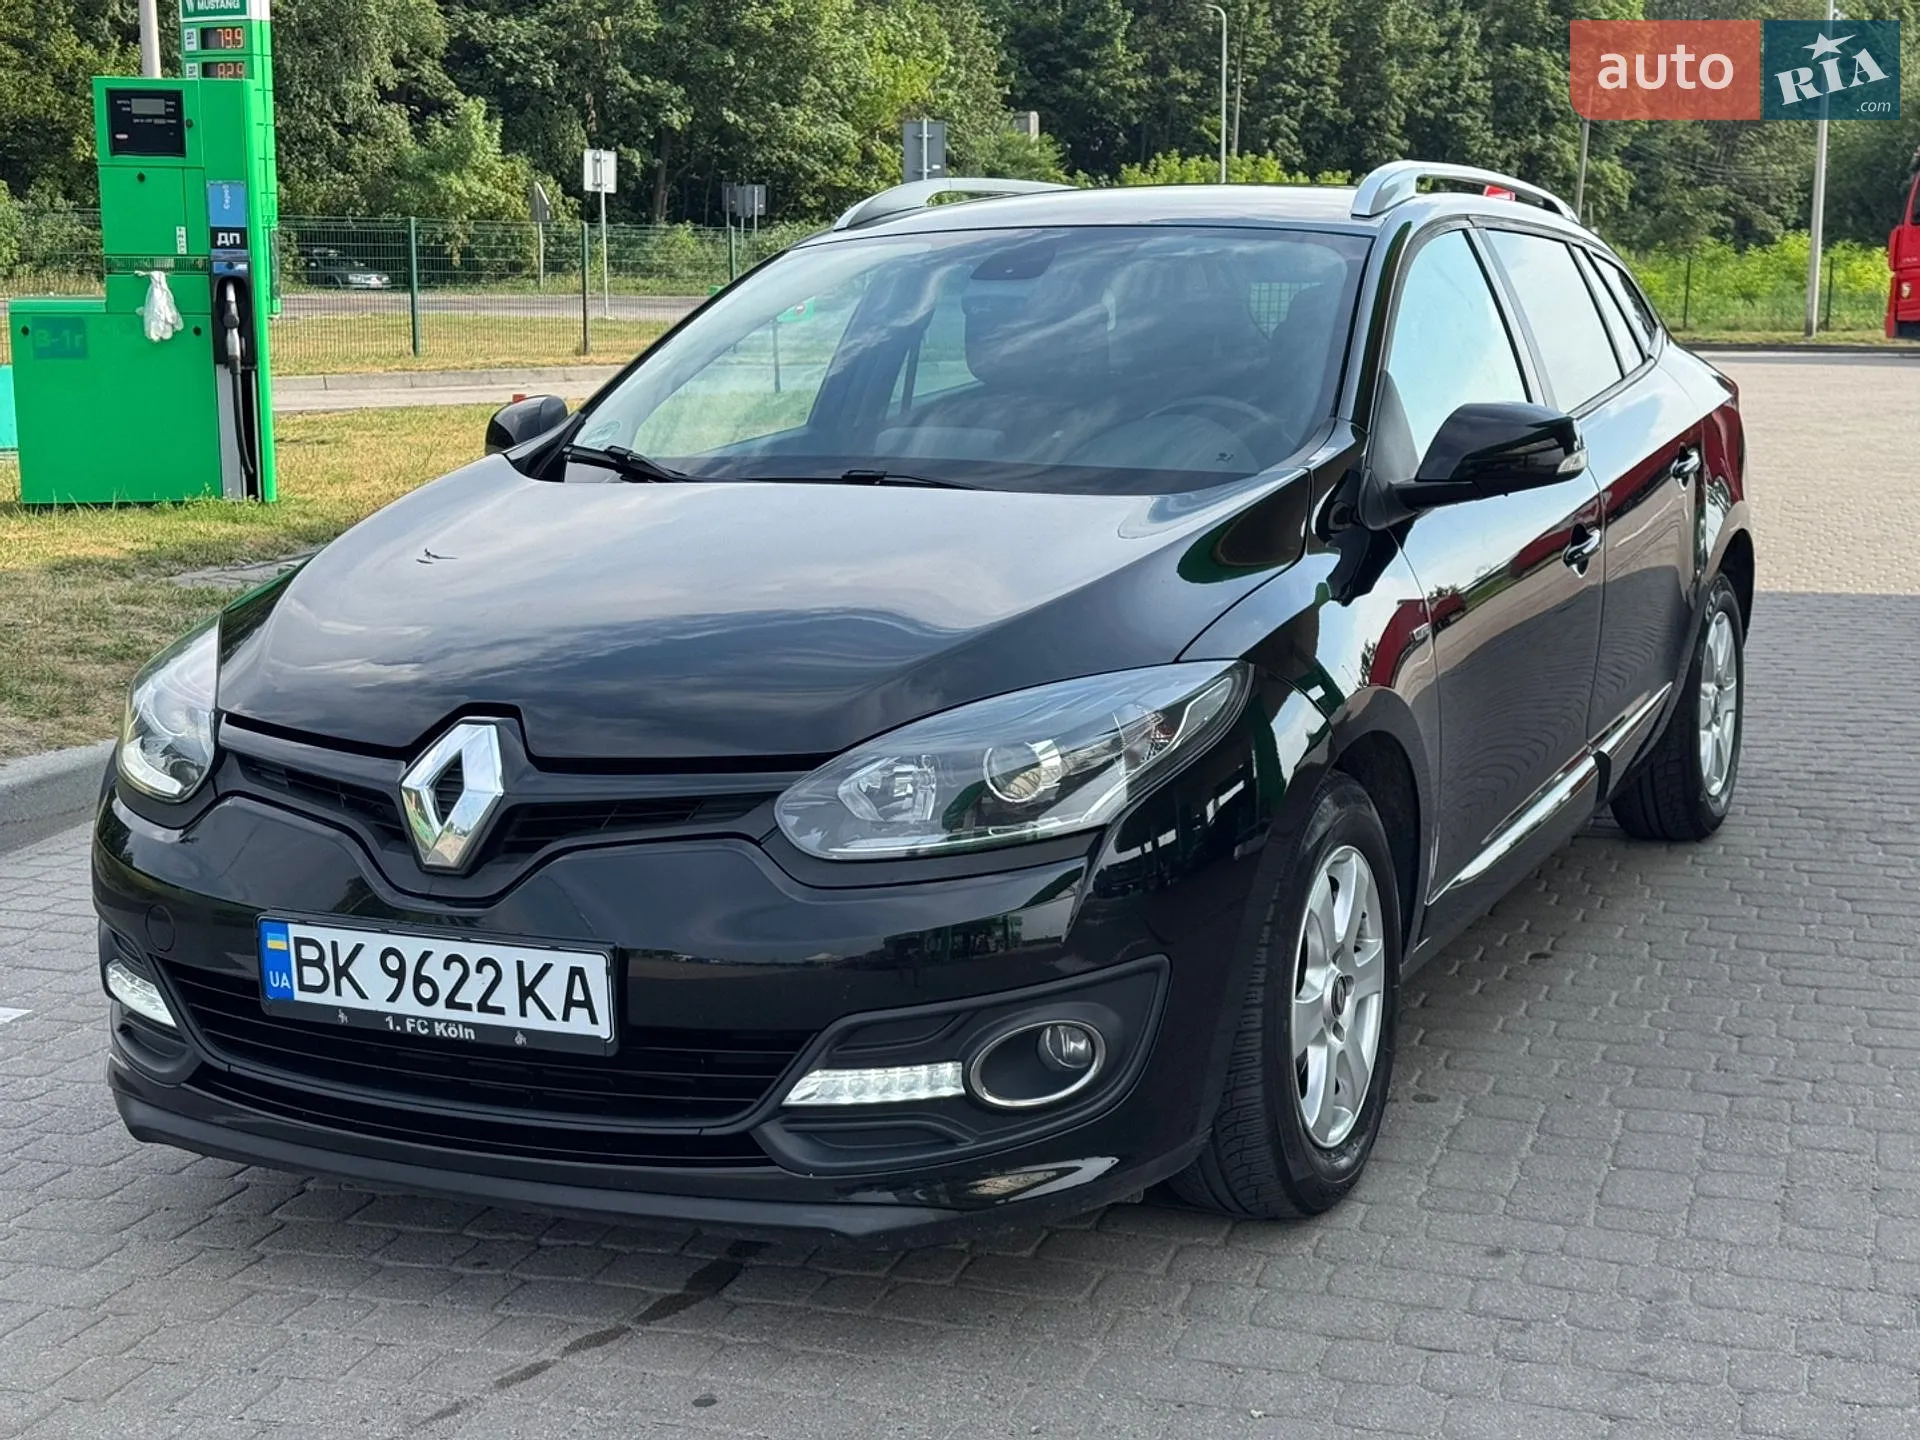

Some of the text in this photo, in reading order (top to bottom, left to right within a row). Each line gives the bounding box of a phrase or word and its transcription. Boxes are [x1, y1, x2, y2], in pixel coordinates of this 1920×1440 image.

[217, 232, 241, 246] ДП
[269, 971, 291, 990] UA
[293, 935, 599, 1026] BK 9622 KA
[385, 1015, 476, 1040] 1. FC Köln
